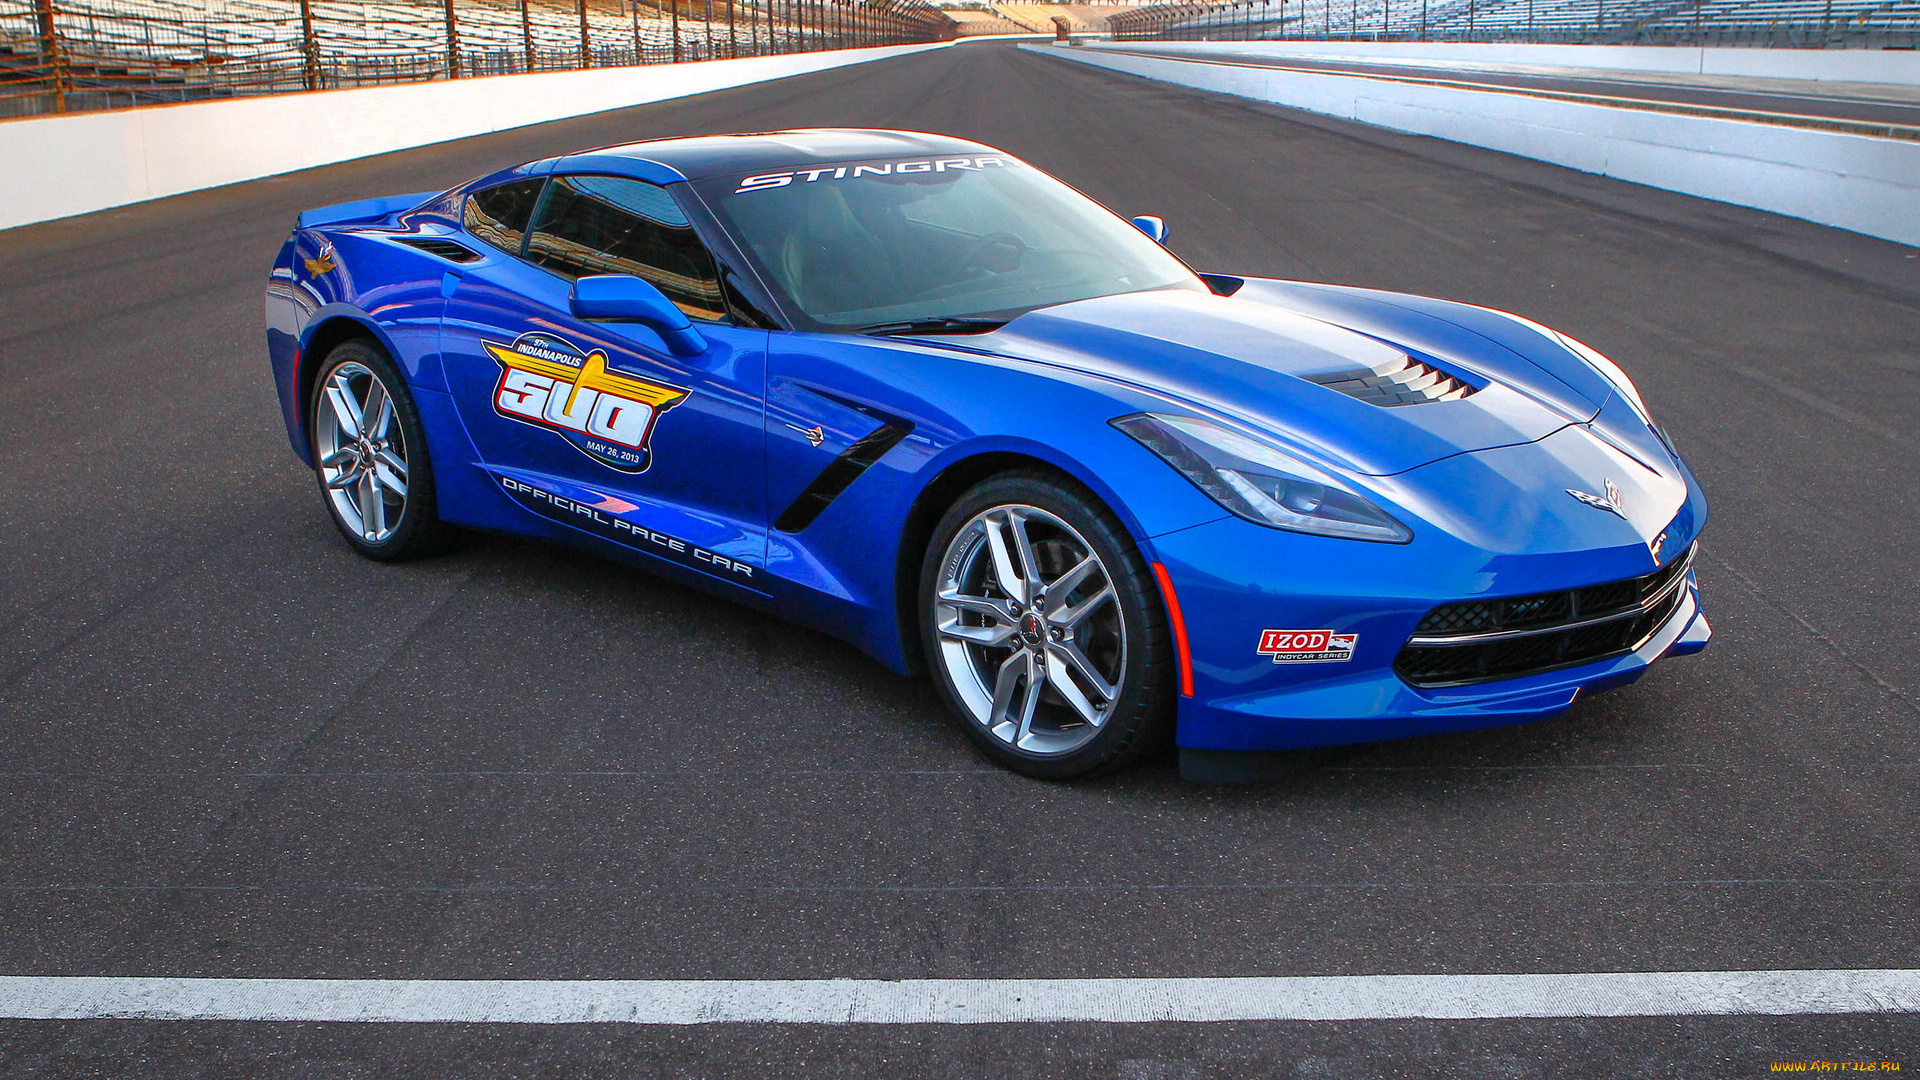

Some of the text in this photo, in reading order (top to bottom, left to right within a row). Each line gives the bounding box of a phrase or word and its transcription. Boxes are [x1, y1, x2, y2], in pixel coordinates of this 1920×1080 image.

[517, 343, 582, 367] INDIANAPOLIS
[498, 367, 654, 448] 500
[586, 440, 640, 463] MAY 26, 2013
[502, 477, 753, 577] OFFICIAL PACE CAR
[1264, 633, 1325, 649] IZOD
